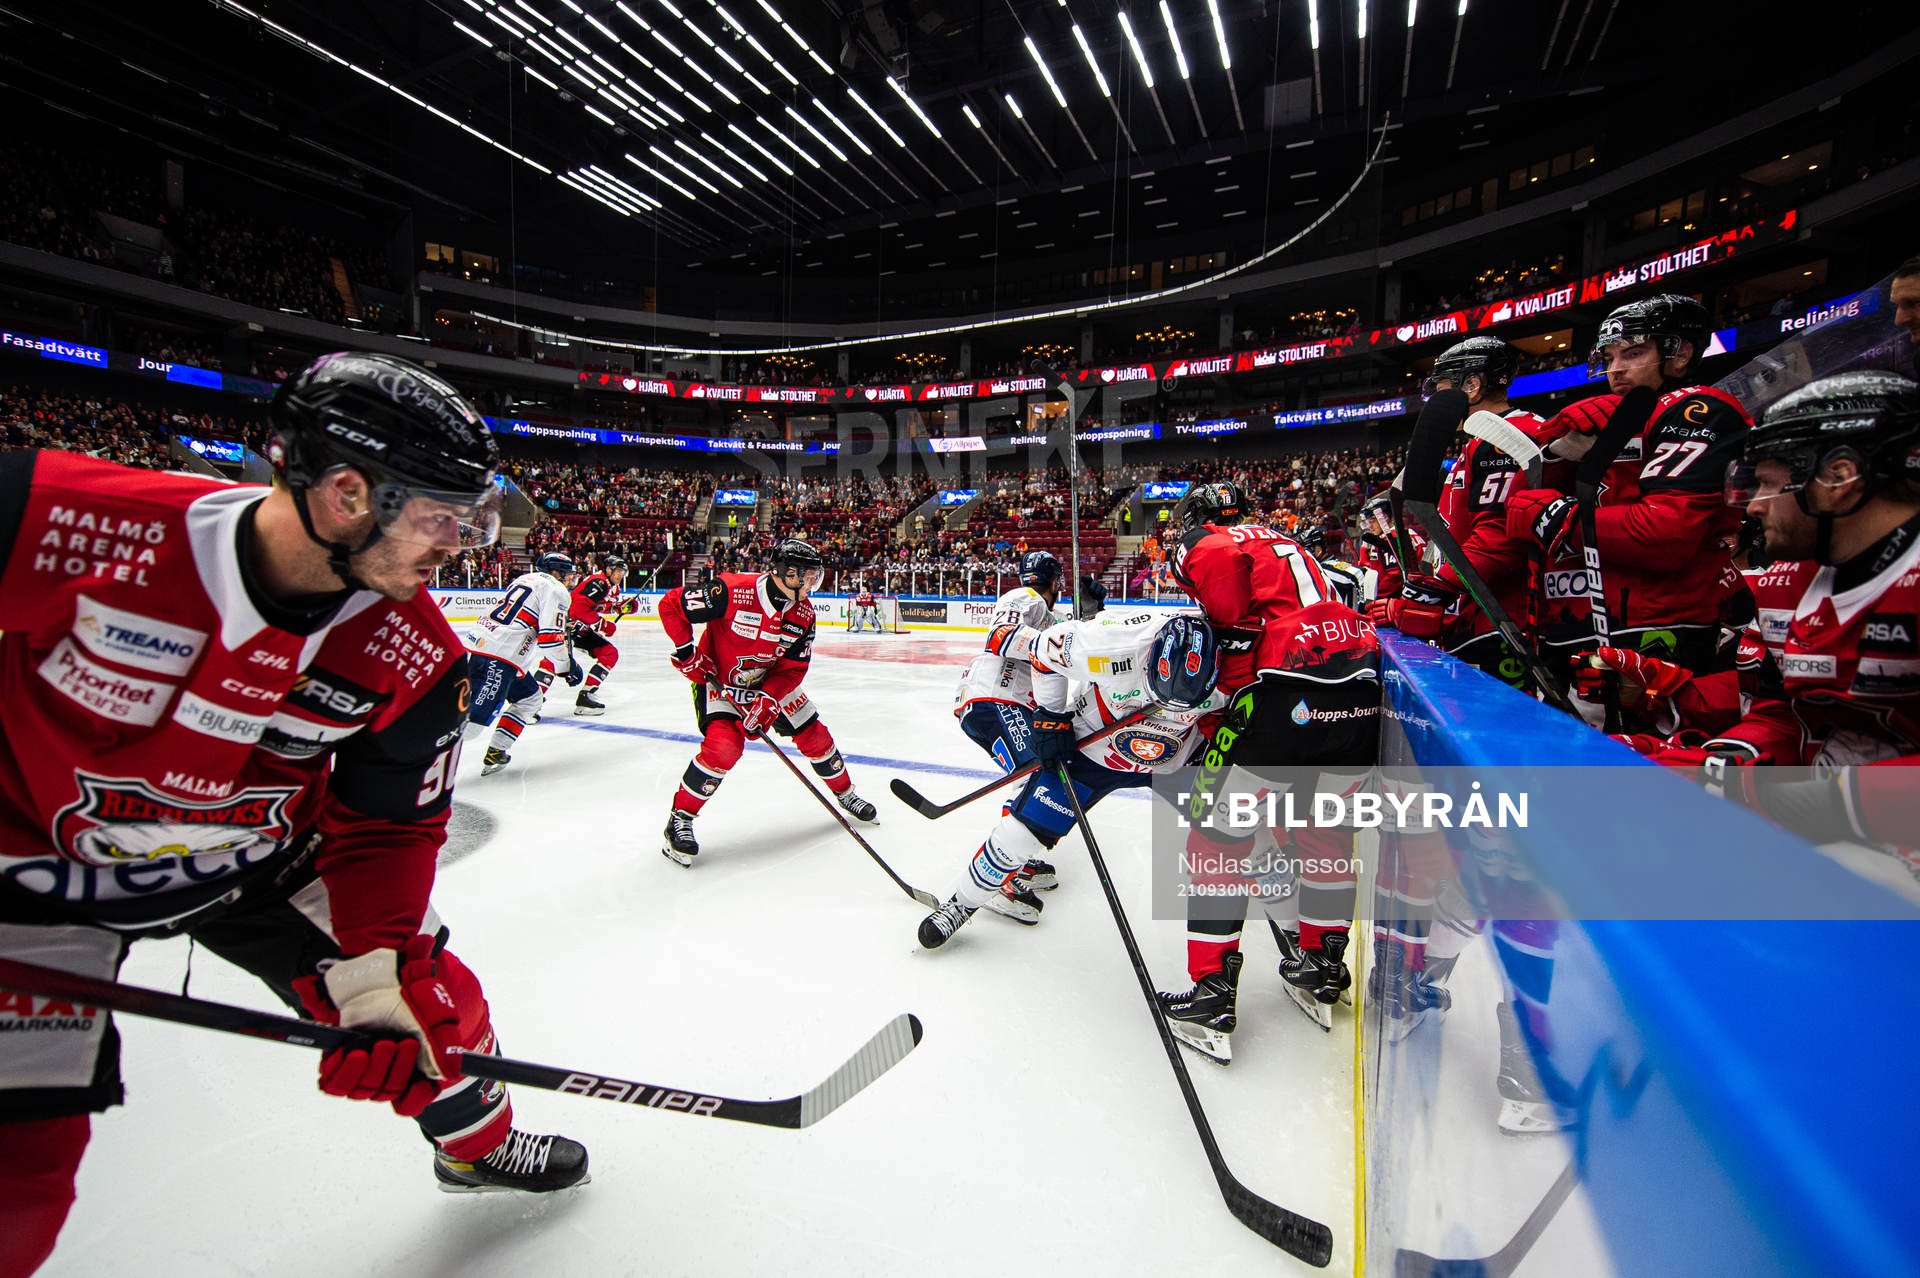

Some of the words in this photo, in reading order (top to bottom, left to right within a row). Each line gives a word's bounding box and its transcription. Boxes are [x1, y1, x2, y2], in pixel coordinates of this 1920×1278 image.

[1640, 244, 1711, 282] STOLTHET
[1515, 288, 1573, 318] KVALITET
[1780, 300, 1860, 333] Relining
[1416, 317, 1458, 339] HJÄRTA
[2, 332, 102, 363] Fasadtvätt
[1278, 344, 1327, 363] STOLTHET
[139, 356, 173, 375] Jour
[1116, 367, 1148, 382] HJÄRTA
[1189, 358, 1231, 375] KVALITET
[638, 380, 669, 395] HJÄRTA
[706, 387, 741, 400] KVALITET
[779, 389, 817, 402] STOLTHET
[878, 388, 905, 401] HJÄRTA
[940, 385, 973, 399] KVALITET
[1010, 378, 1046, 392] STOLTHET
[1010, 434, 1047, 446] Relining
[1273, 411, 1323, 425] Taktvätt
[1324, 410, 1335, 420] &
[1337, 401, 1402, 417] Fasadtvätt
[1820, 418, 1876, 431] CCM
[326, 422, 389, 451] CCM
[512, 422, 597, 442] Avloppsspolning
[707, 439, 746, 451] Taktvätt
[747, 441, 755, 450] &
[756, 440, 804, 451] Fasadtvätt
[822, 441, 841, 452] Jour
[954, 439, 980, 450] Allpipe
[206, 444, 233, 457] Allpipe
[1640, 441, 1709, 480] 27
[1480, 457, 1523, 469] exakt
[1478, 472, 1516, 506] 51
[47, 506, 168, 546] MALMÖ
[40, 528, 157, 567] ARENA
[34, 551, 150, 587] HOTEL
[1758, 575, 1792, 588] OTEL
[455, 597, 498, 606] Climat80
[684, 589, 706, 612] 34
[1401, 585, 1441, 605] CM
[555, 612, 565, 628] 6
[993, 610, 1021, 625] 28
[1768, 619, 1792, 630] TREA
[384, 610, 446, 664] MALMÖ
[787, 624, 804, 636] RSA
[1864, 623, 1911, 642] RSA
[103, 624, 195, 659] TREANO
[373, 625, 436, 677] ARENA
[774, 646, 786, 657] C
[248, 649, 292, 671] SHL
[364, 640, 426, 689] HOTEL
[58, 650, 157, 706] Prioritet
[474, 660, 498, 706] WELLNESS
[485, 668, 504, 701] NORDIC
[60, 672, 131, 718] Finans
[221, 678, 284, 703] CCM
[305, 678, 376, 717] RSA
[782, 691, 808, 715] MAXI
[996, 703, 1027, 752] ELLNESS
[1008, 703, 1031, 737] ORDIC
[1033, 720, 1070, 732] CCM
[1296, 708, 1349, 726] Avlopps
[100, 789, 270, 825] REDHAWKS
[982, 862, 1004, 880] STENA
[1170, 1002, 1192, 1011] CCM
